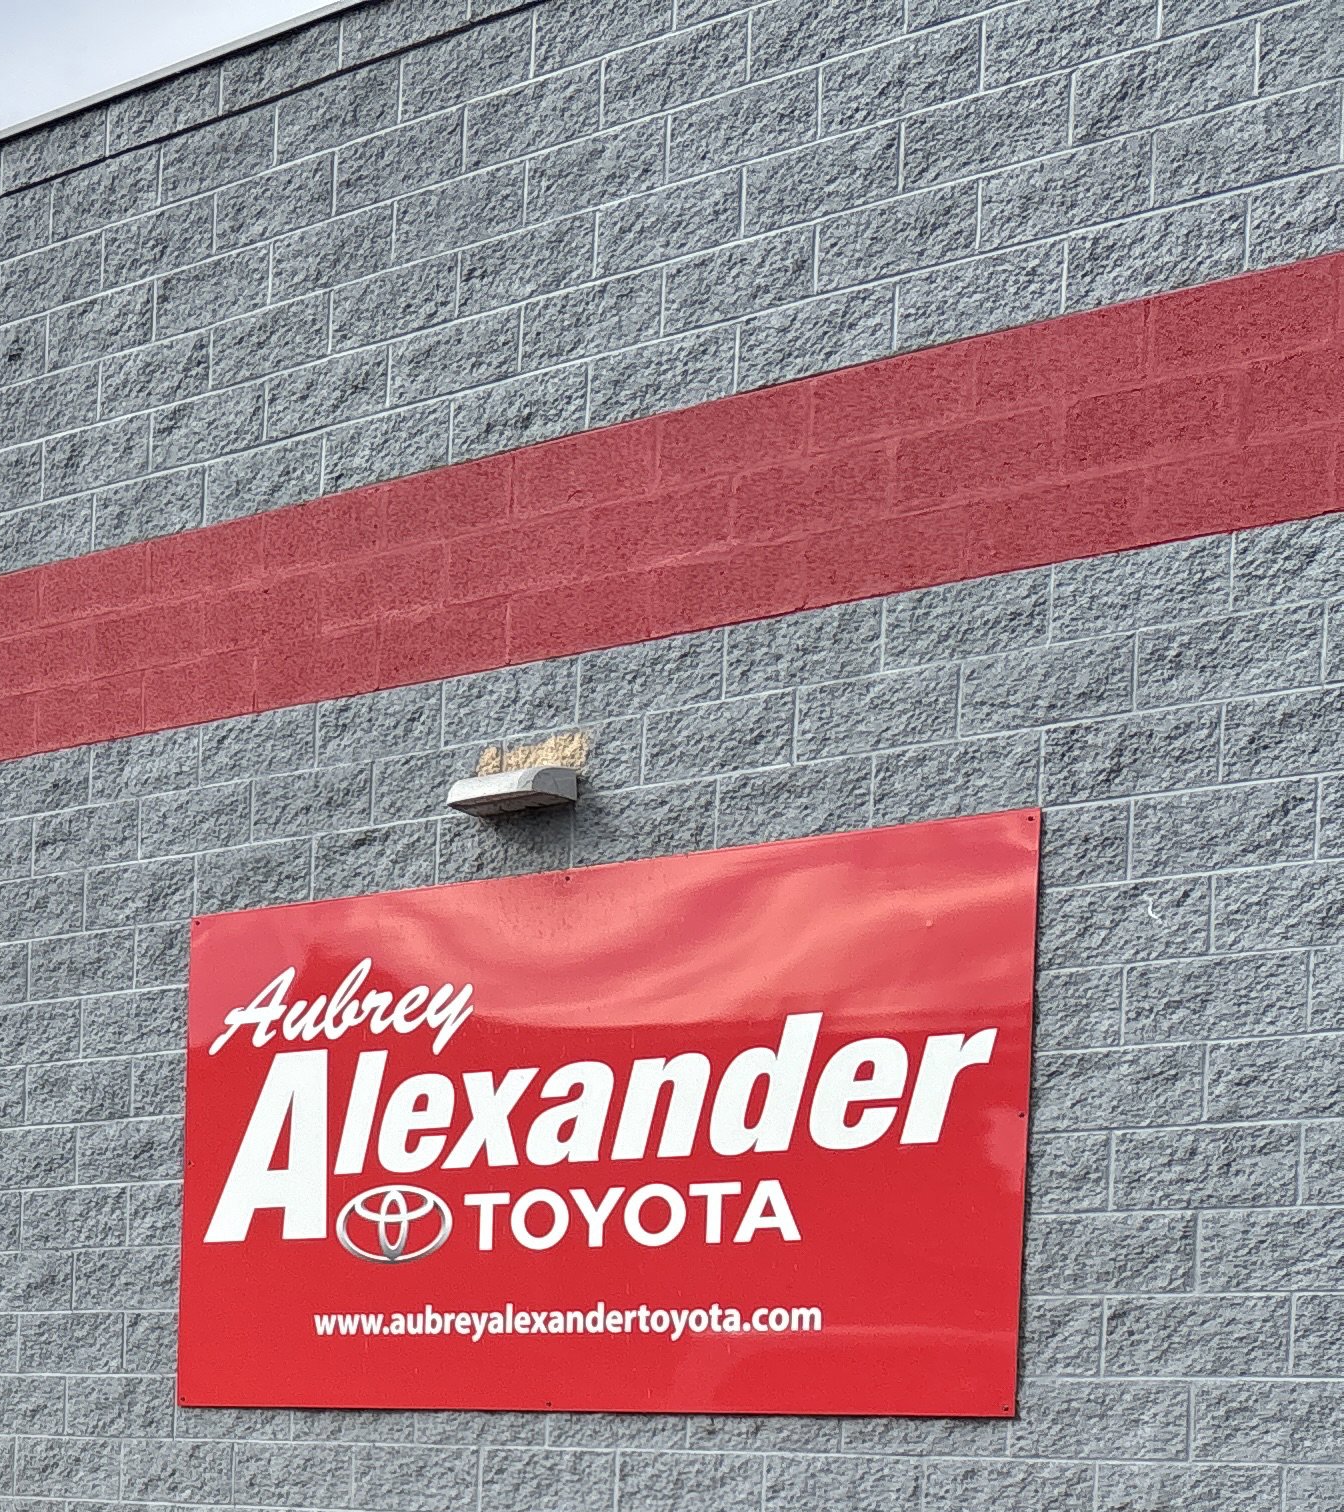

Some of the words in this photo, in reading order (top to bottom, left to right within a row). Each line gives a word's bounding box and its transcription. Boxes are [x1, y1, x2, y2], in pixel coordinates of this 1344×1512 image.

[208, 957, 474, 1057] Aubrey
[204, 1011, 998, 1243] Alexander
[464, 1179, 801, 1251] TOYOTA
[313, 1301, 822, 1343] www.aubreyalexandertoyota.com
